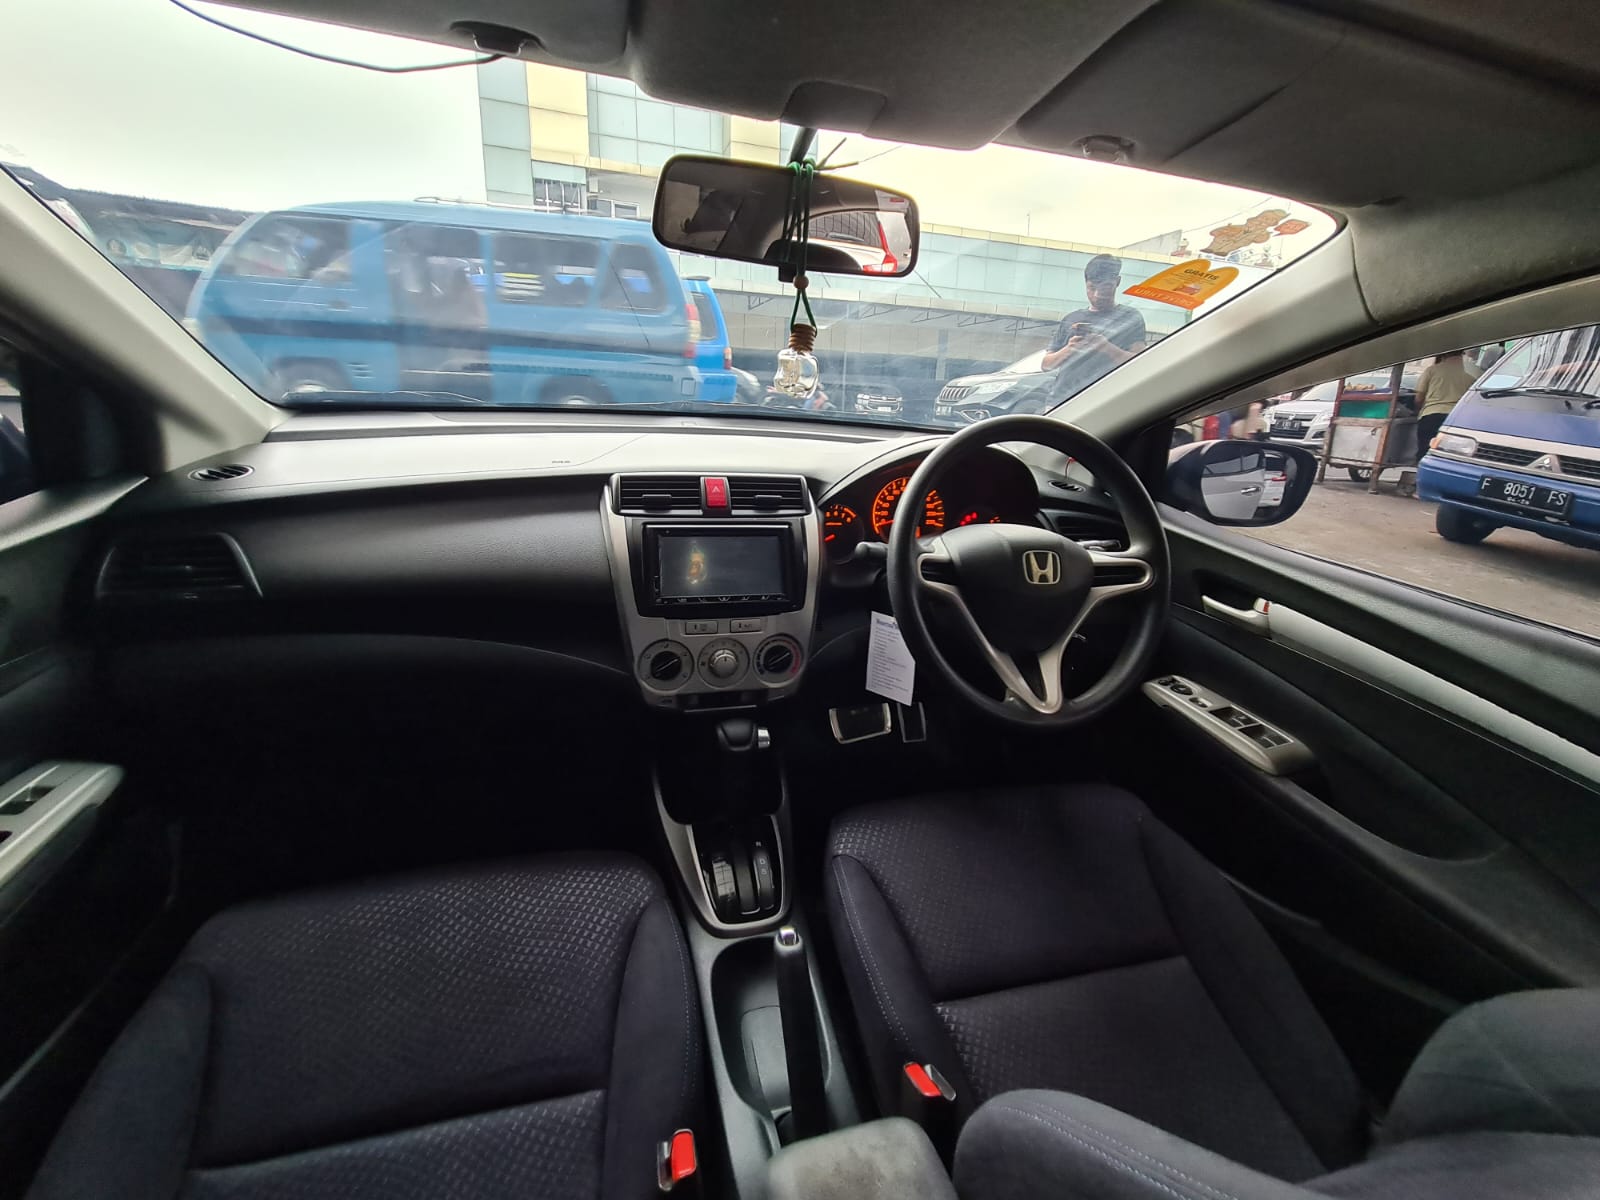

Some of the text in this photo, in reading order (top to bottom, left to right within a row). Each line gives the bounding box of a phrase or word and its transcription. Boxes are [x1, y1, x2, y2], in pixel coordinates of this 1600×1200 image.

[1184, 269, 1219, 281] GRATIS
[1482, 478, 1566, 504] F 8051 FS
